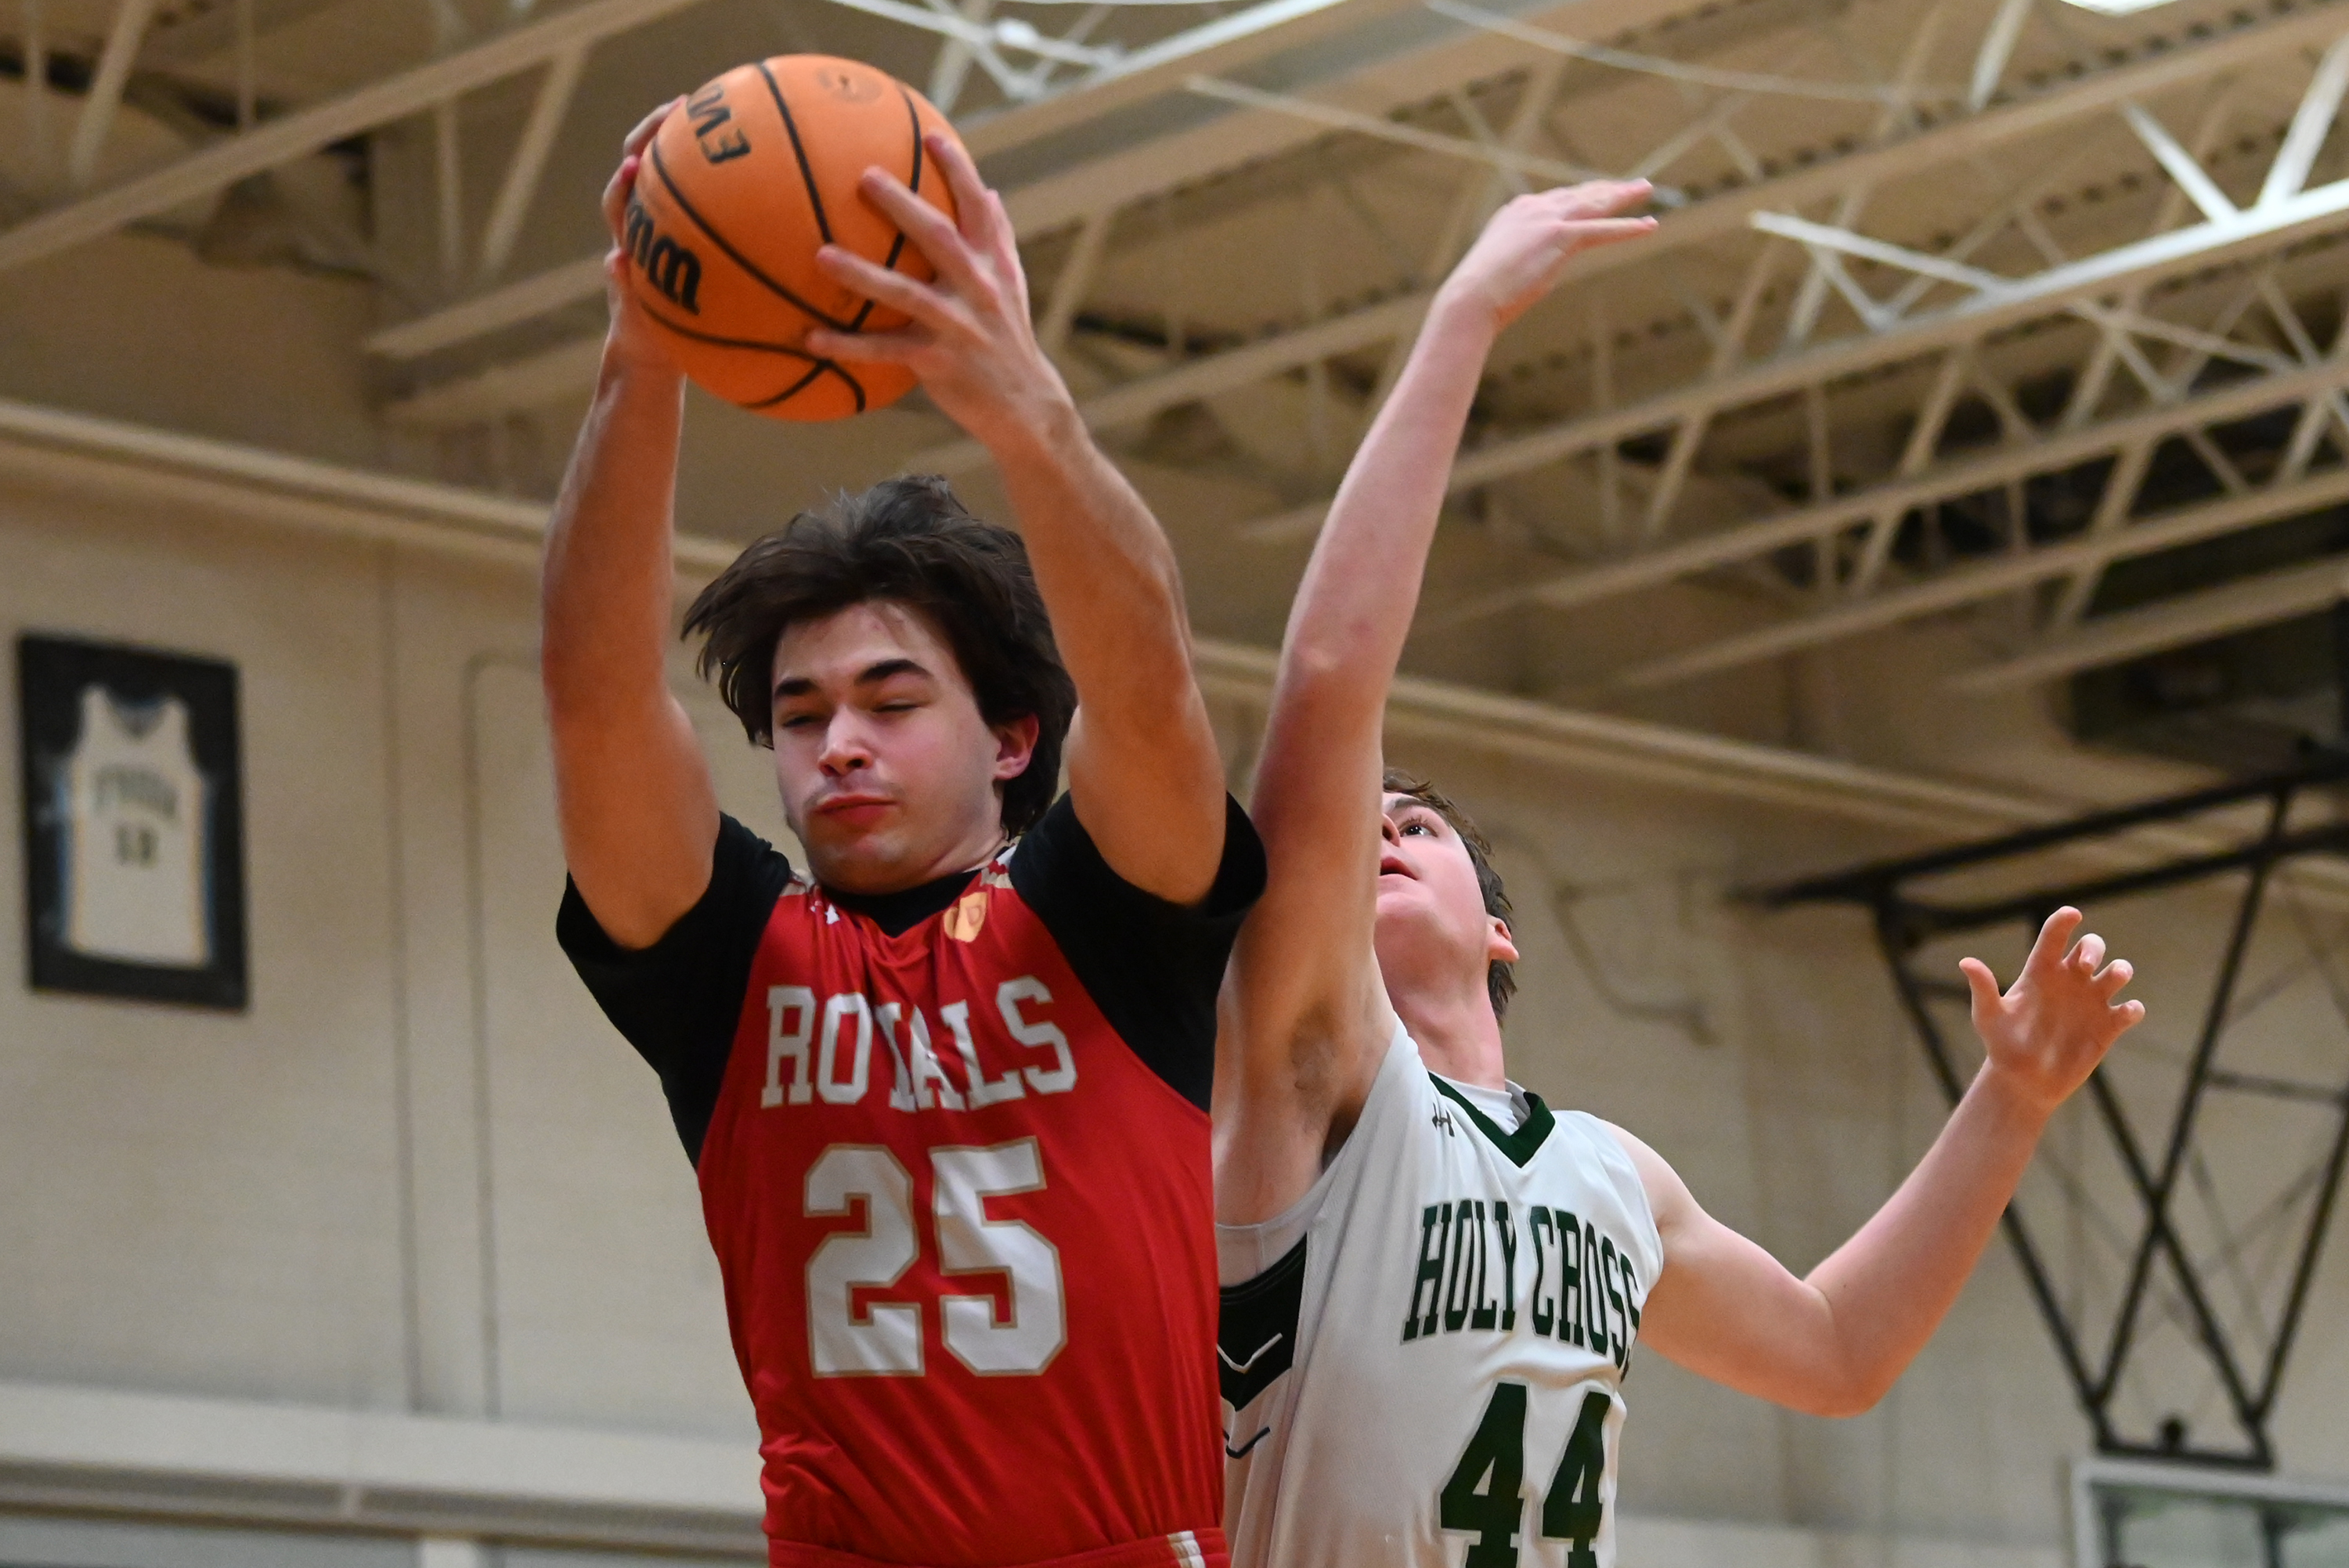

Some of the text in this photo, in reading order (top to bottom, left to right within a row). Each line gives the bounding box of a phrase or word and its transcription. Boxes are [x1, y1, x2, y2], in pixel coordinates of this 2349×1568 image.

[761, 975, 1077, 1112] ROYALS
[803, 1135, 1068, 1379] 25
[1400, 1199, 1640, 1383] HOLY CROSS
[1438, 1379, 1613, 1568] 44
